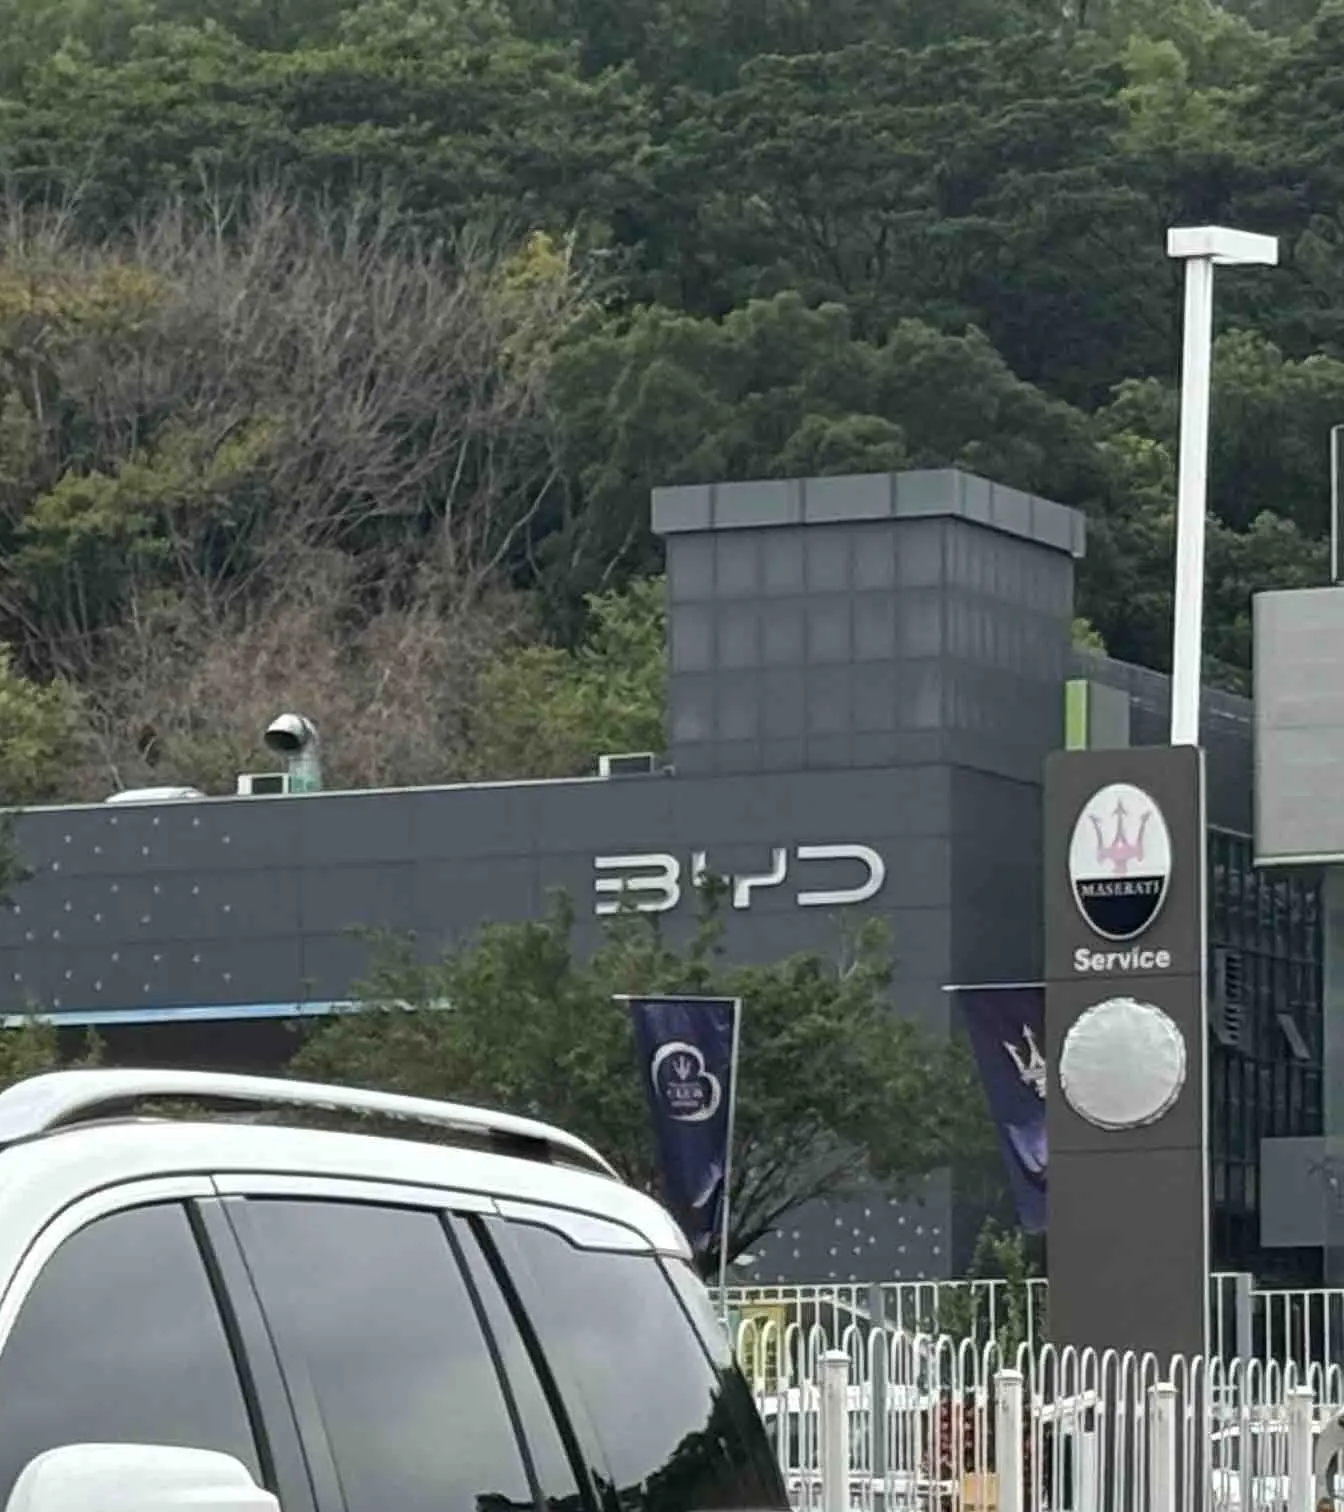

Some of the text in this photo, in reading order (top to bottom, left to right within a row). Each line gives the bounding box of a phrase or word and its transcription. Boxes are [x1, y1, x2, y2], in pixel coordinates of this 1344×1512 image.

[594, 844, 886, 916] BYD
[1081, 880, 1160, 898] MASERATI
[1074, 945, 1171, 972] Service
